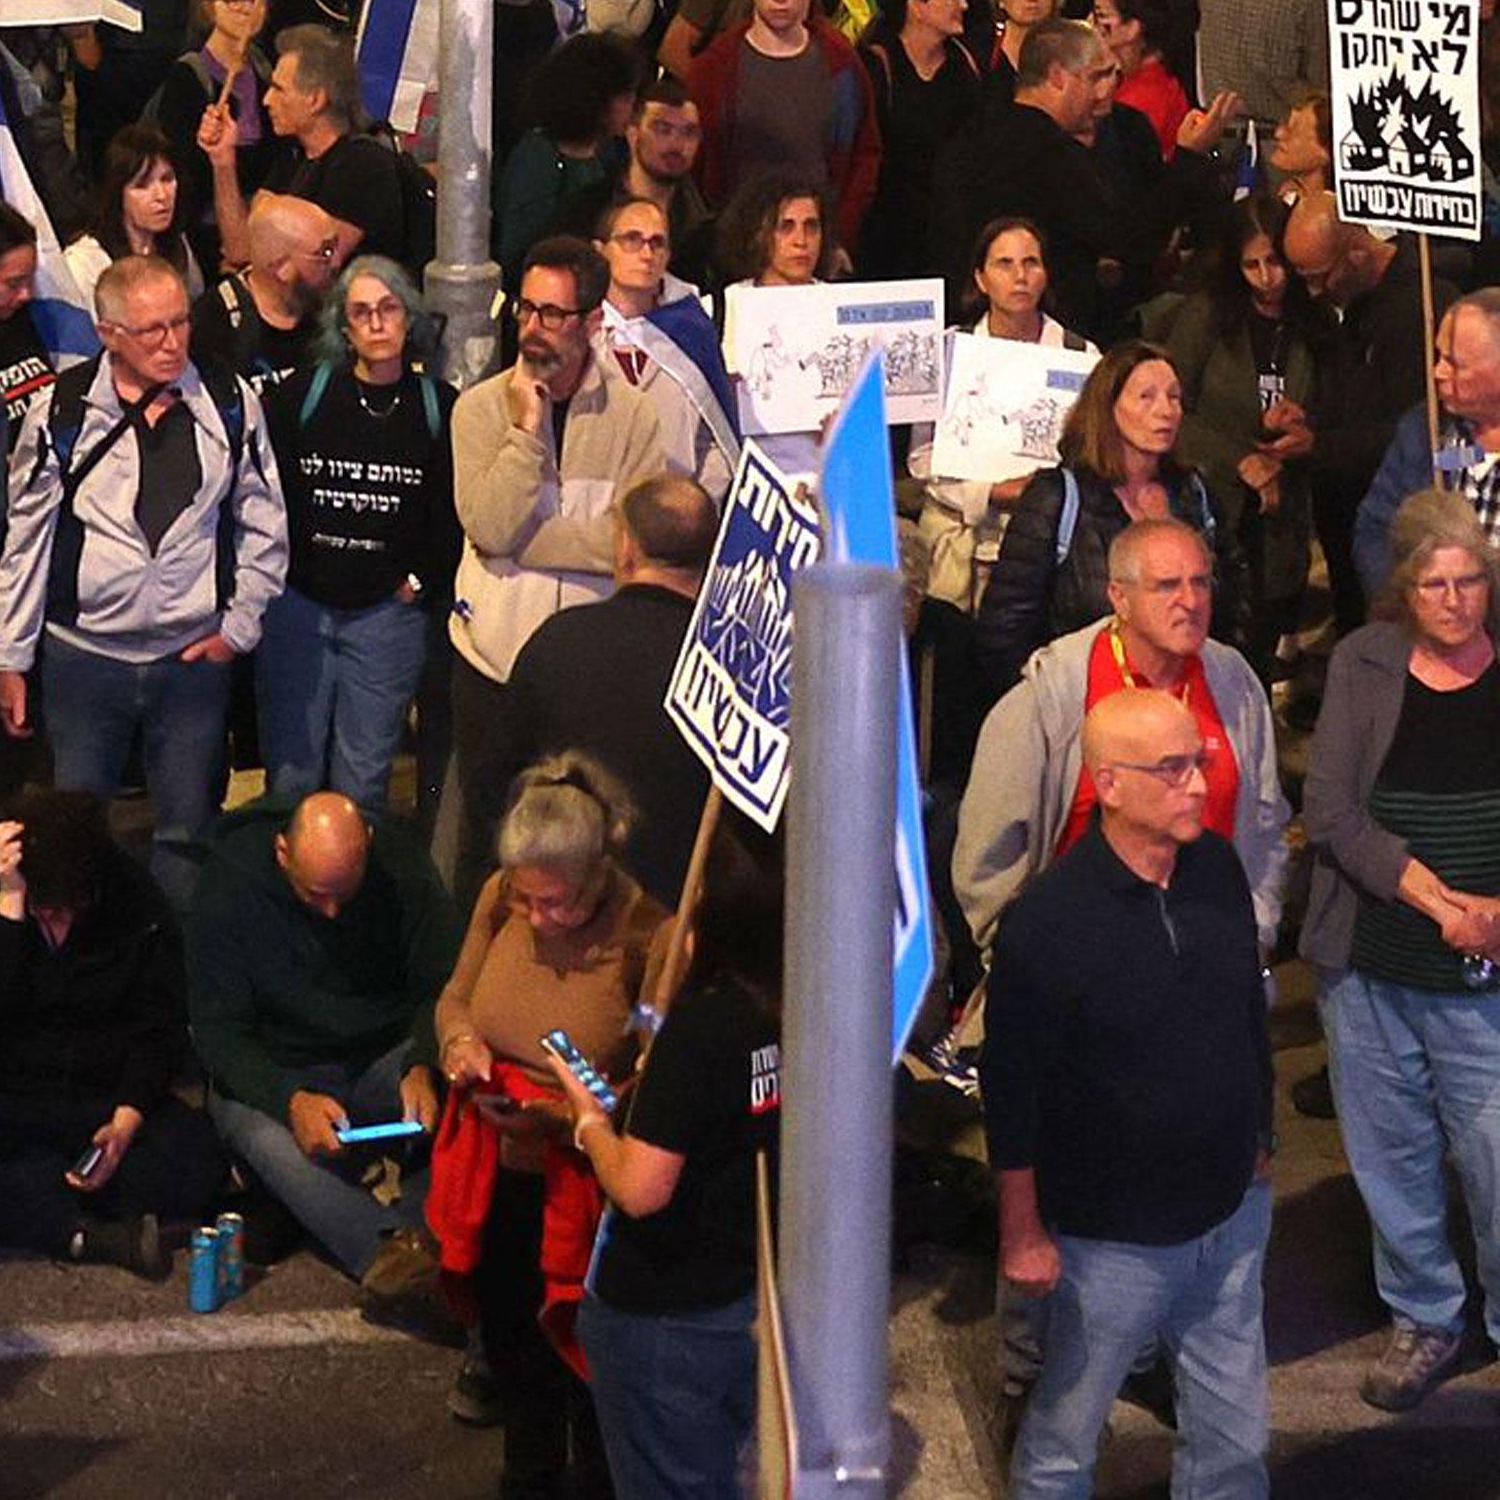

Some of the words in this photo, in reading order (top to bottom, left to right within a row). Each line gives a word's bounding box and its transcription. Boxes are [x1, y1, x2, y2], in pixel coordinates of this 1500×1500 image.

[1428, 3, 1471, 37] מי
[1340, 32, 1403, 69] יתקן
[1412, 38, 1468, 75] לא
[1414, 192, 1475, 225] בחירות
[313, 488, 401, 513] דמוקרטיה
[739, 463, 820, 571] חירות
